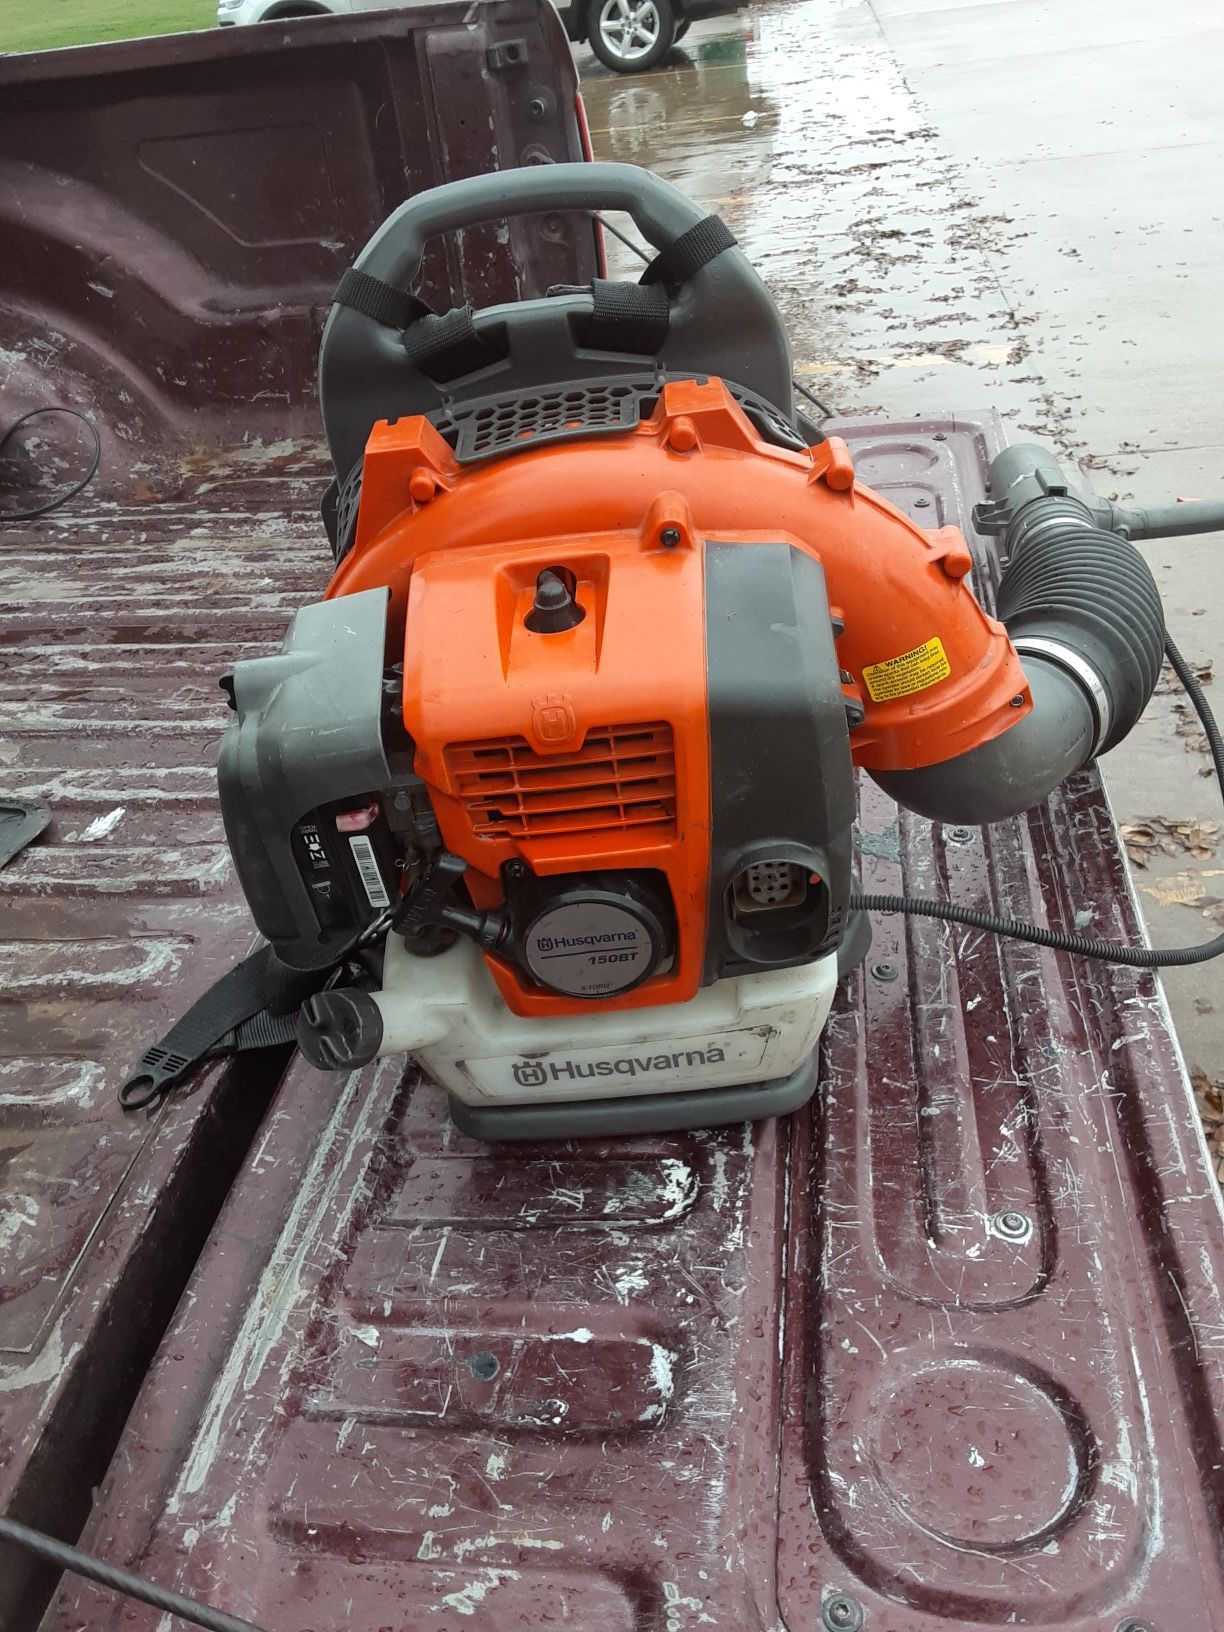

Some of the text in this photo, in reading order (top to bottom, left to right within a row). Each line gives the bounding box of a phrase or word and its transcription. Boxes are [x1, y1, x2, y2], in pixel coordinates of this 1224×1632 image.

[884, 645, 927, 667] WARNING!
[554, 931, 637, 948] Husqvarna
[587, 952, 639, 965] 150BT
[549, 1047, 726, 1081] Husqvarna
